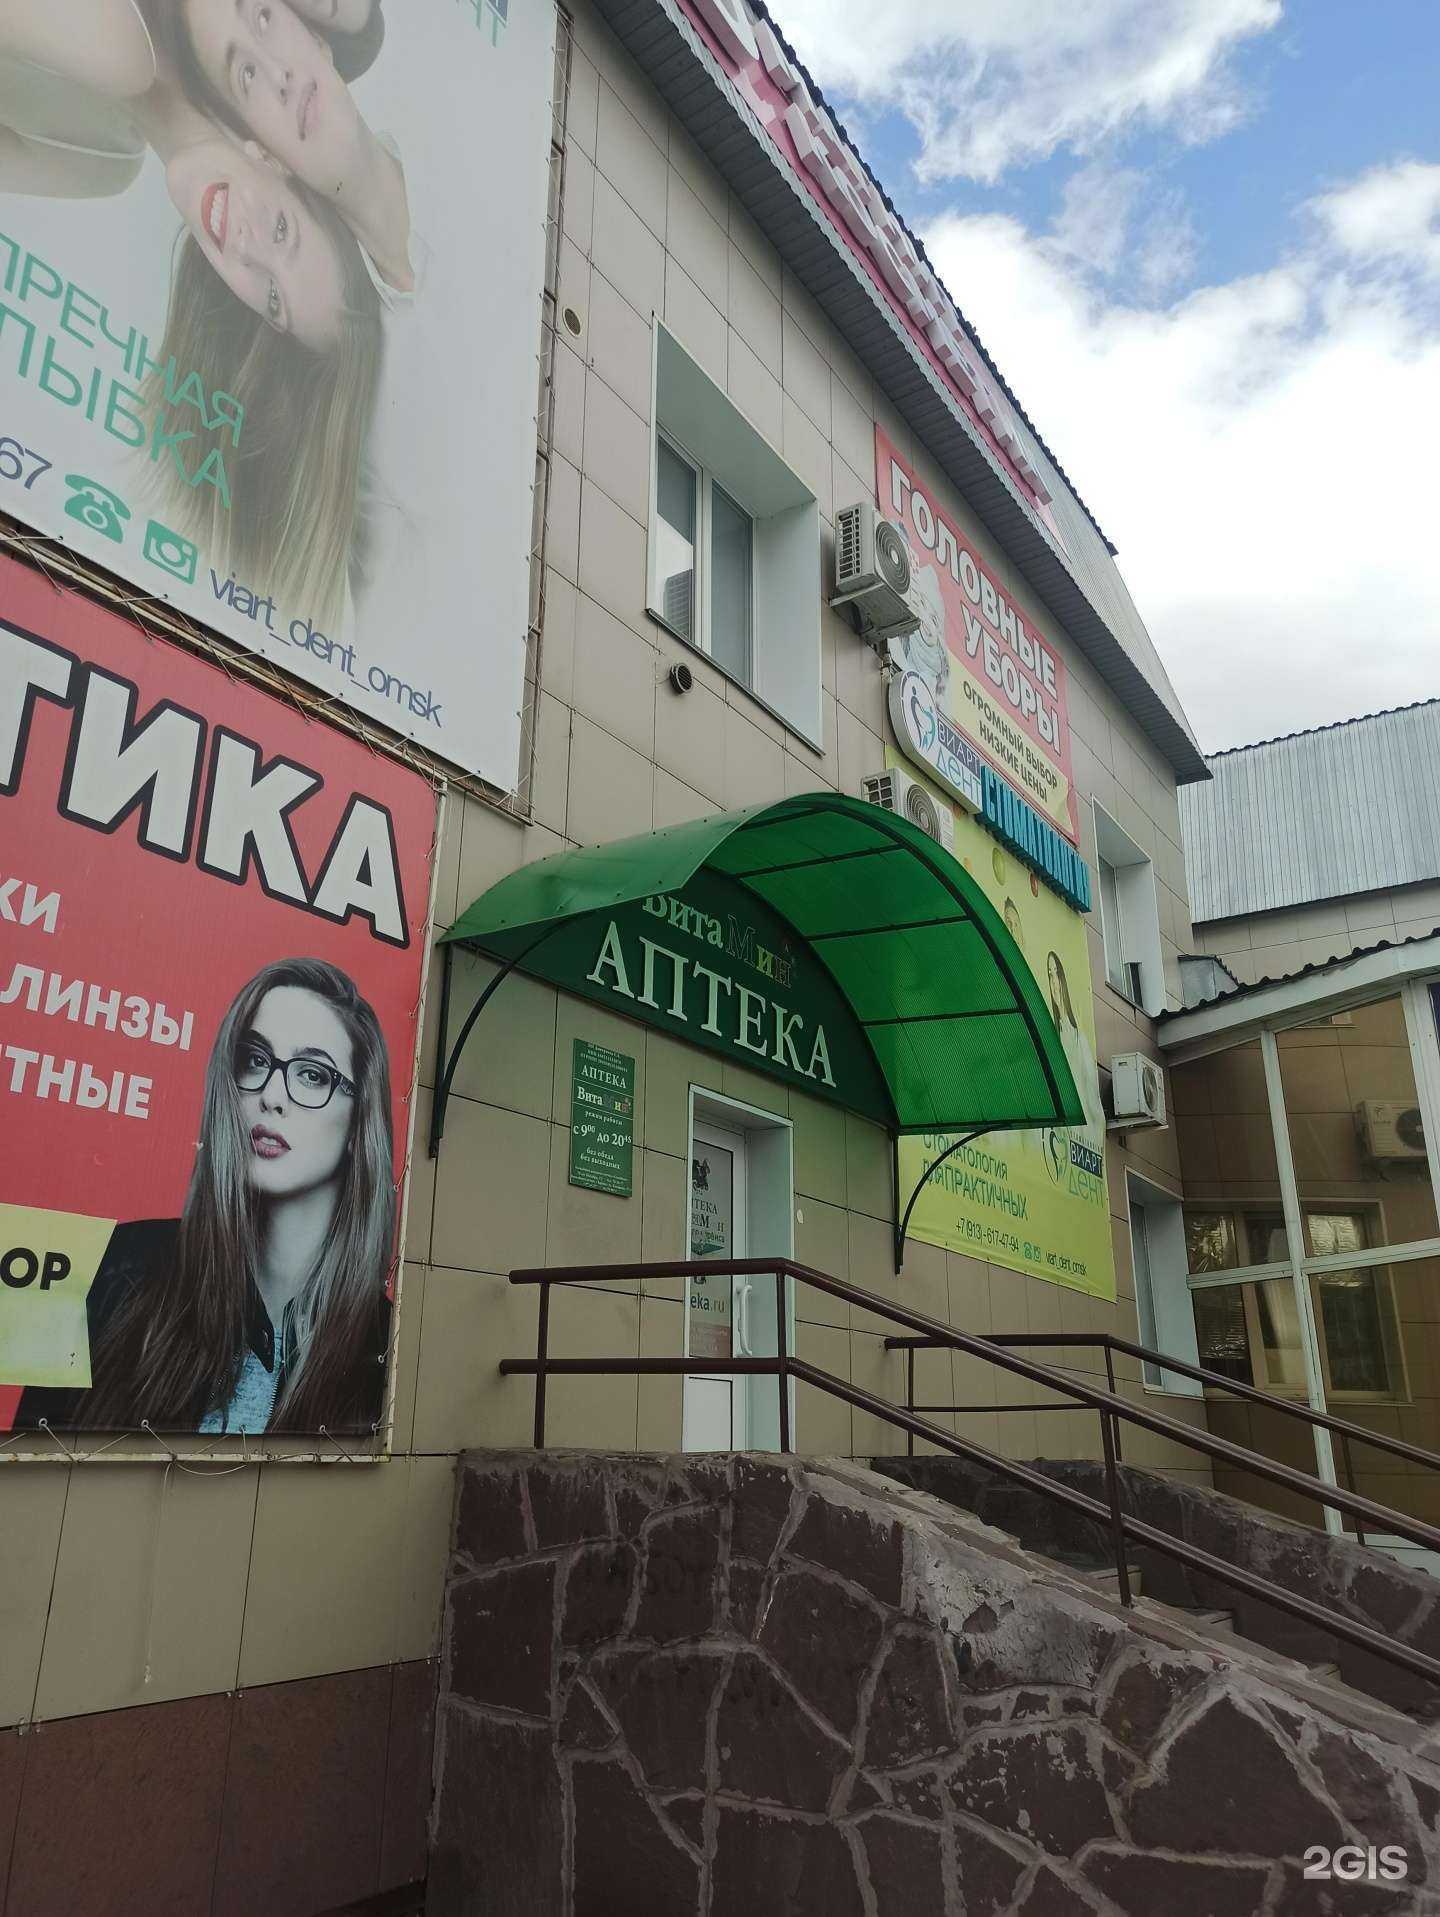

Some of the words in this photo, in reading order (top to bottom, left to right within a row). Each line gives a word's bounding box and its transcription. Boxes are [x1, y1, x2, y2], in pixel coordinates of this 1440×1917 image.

[0, 437, 52, 490] 67
[891, 458, 1059, 704] ГОЛОВНЫЕ
[210, 568, 442, 728] viart_dent_omsk
[960, 601, 1061, 757] УБОРЫ
[937, 721, 980, 777] ВИАРТ
[963, 680, 1024, 757] ОГРОМНЫЙ
[1026, 746, 1058, 790] ВЫБОР
[979, 720, 1019, 774] НИЗКИЕ
[1020, 763, 1048, 801] ЦЕНЫ
[0, 618, 409, 949] ТИКА
[0, 963, 194, 1051] ЛИНЗЫ
[586, 920, 837, 1088] АПТЕКА
[0, 1045, 153, 1120] ТНЫЕ
[581, 1063, 627, 1089] АПТЕКА
[943, 1164, 1029, 1221] ПРАКТИЧНЫХ
[1070, 1142, 1102, 1176] ВИАРТ
[691, 1197, 718, 1216] ТЕКА
